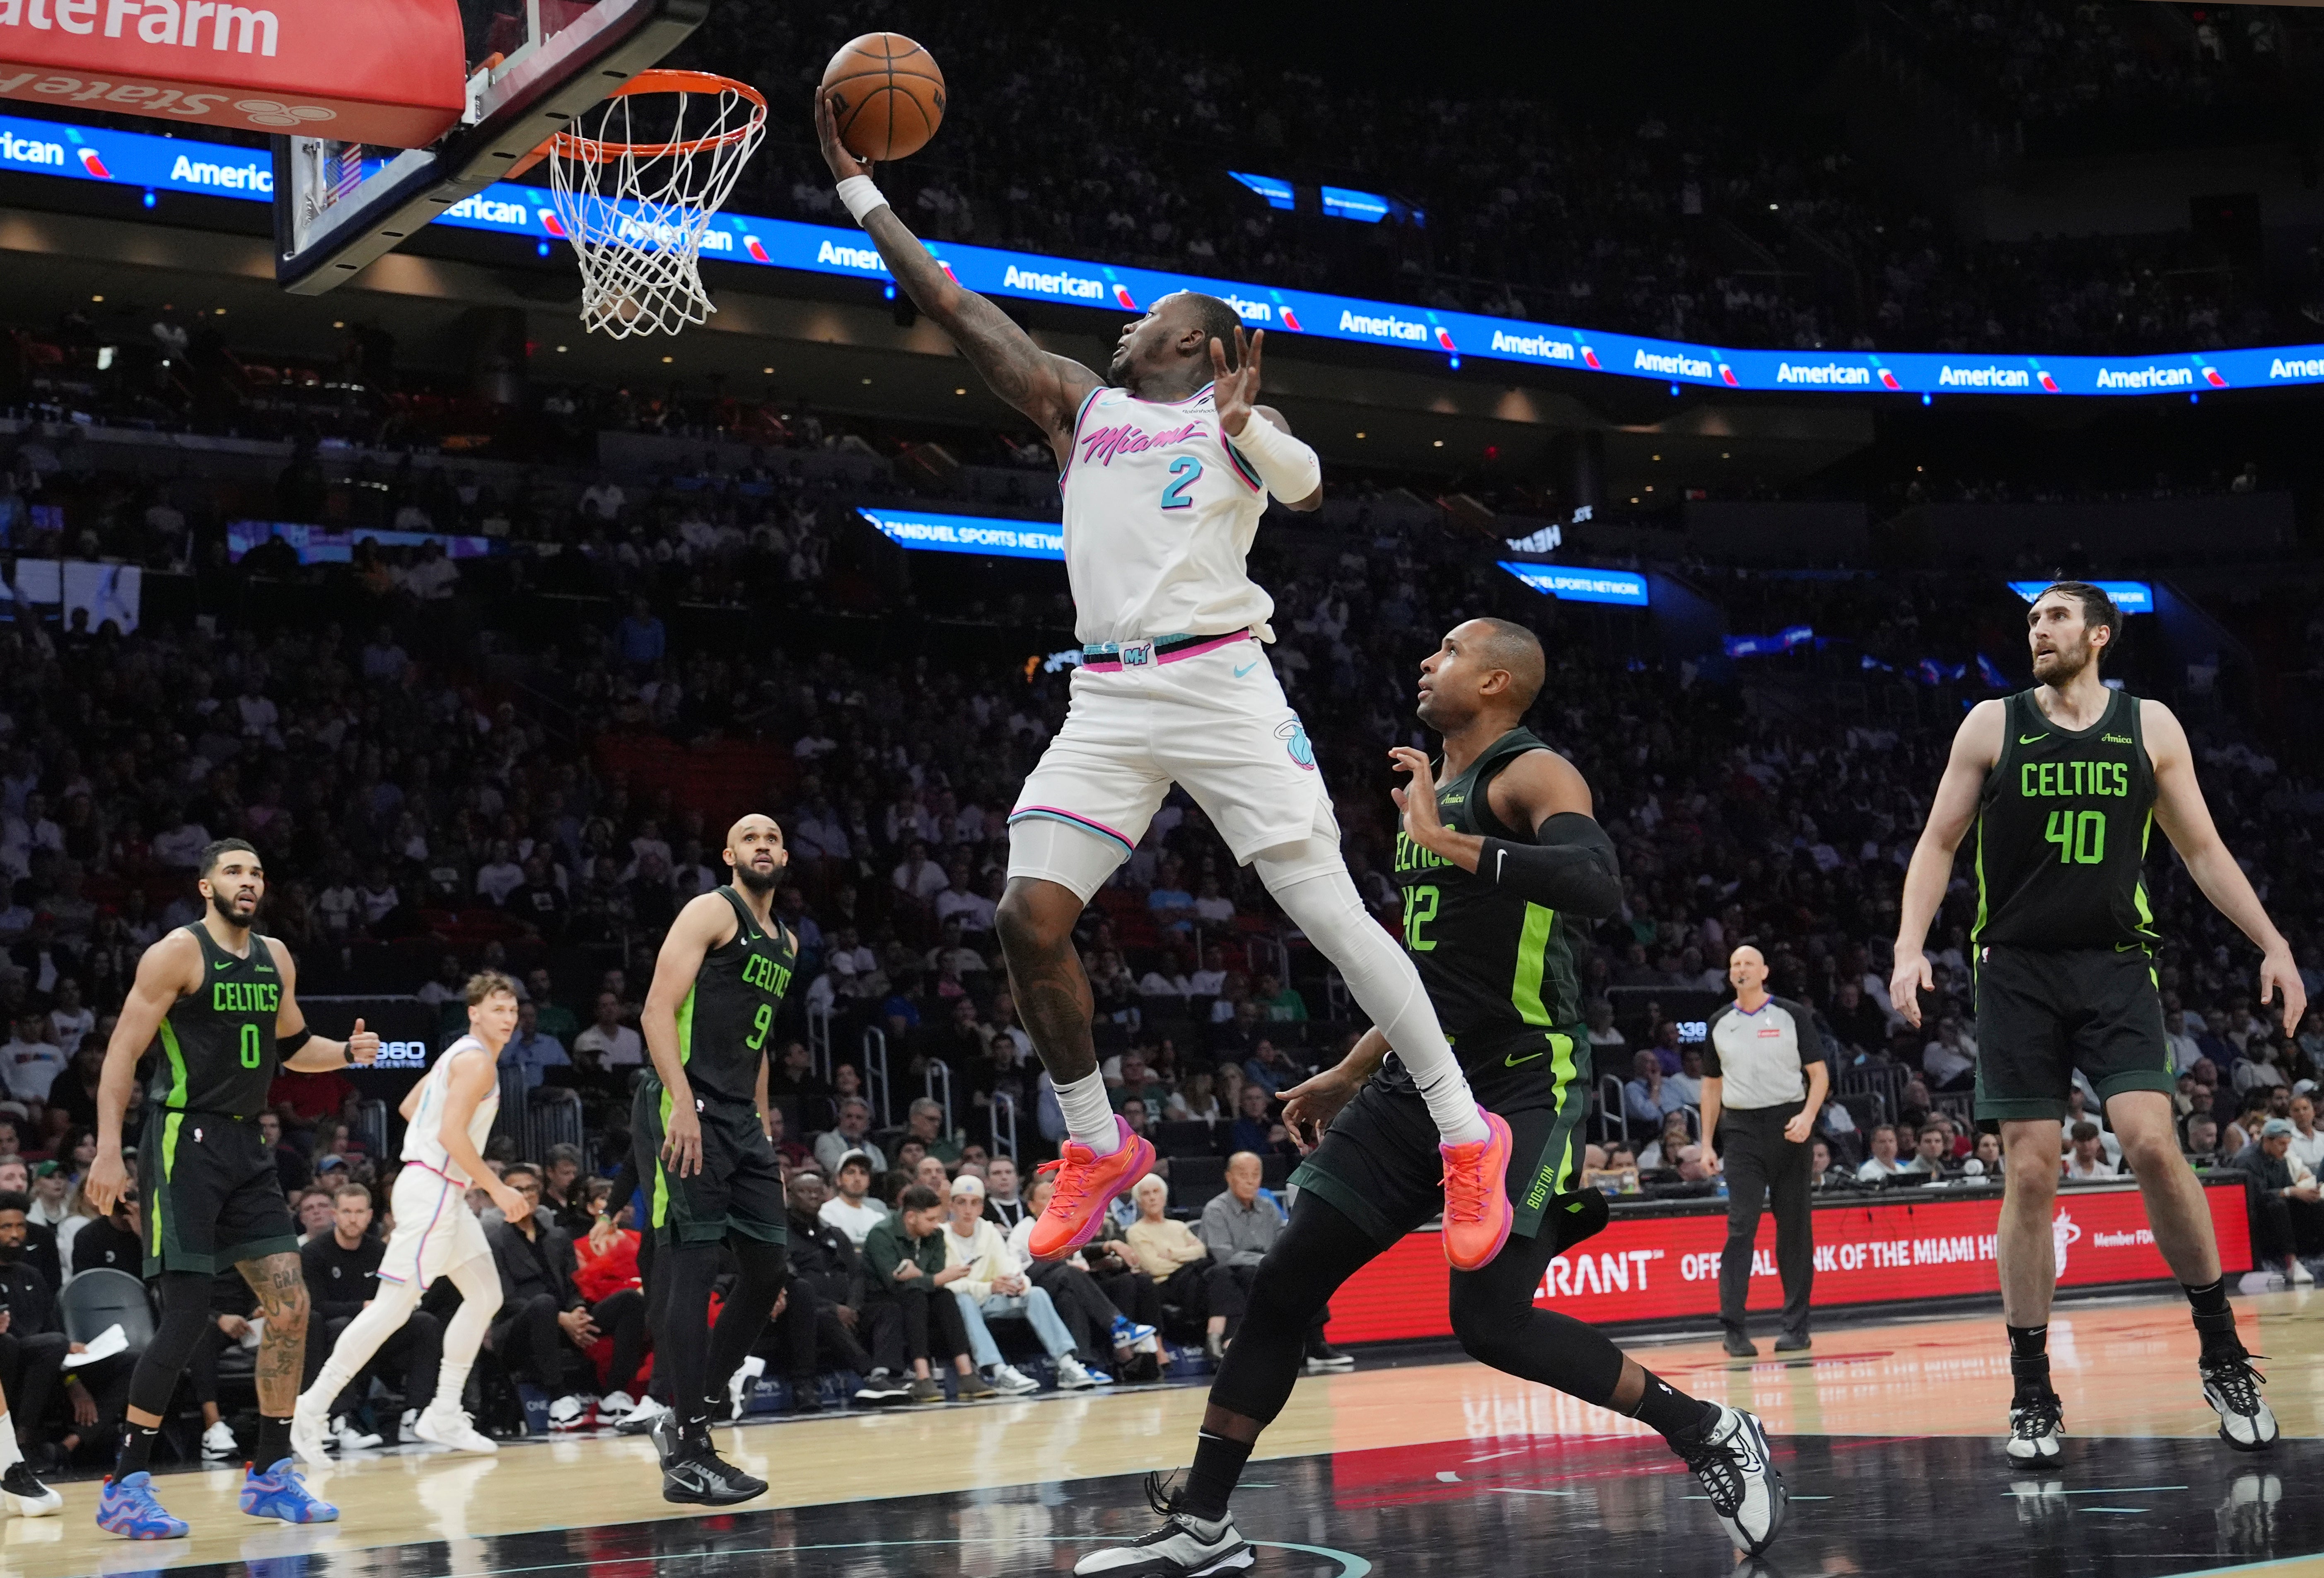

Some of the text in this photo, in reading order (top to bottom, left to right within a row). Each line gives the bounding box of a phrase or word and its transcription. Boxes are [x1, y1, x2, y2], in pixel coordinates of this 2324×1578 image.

[0, 132, 64, 165] ican
[441, 194, 527, 224] erican
[1004, 265, 1104, 299] American
[1221, 294, 1271, 321] ican
[1339, 310, 1427, 341] American
[1492, 331, 1574, 360] American
[1634, 349, 1712, 378] American
[1777, 363, 1870, 384] American
[1939, 366, 2029, 386] American
[2097, 366, 2193, 388] American
[1081, 420, 1208, 467] Miami
[1161, 456, 1203, 511] 2
[958, 527, 1017, 547] SPORTS
[2102, 733, 2133, 744] Amica
[2022, 761, 2128, 797] CELTICS
[1441, 794, 1464, 805] Amica
[2044, 811, 2106, 864] 40
[213, 982, 278, 1012] CELTICS
[746, 1004, 772, 1050] 9
[241, 1023, 260, 1069] 0
[1526, 1164, 1555, 1210] BOSTON
[2093, 1230, 2135, 1248] Member
[1534, 1250, 1652, 1299] RANT
[1839, 1243, 1867, 1270] OF
[1869, 1240, 1911, 1268] THE
[1913, 1235, 1975, 1265] MIAMI
